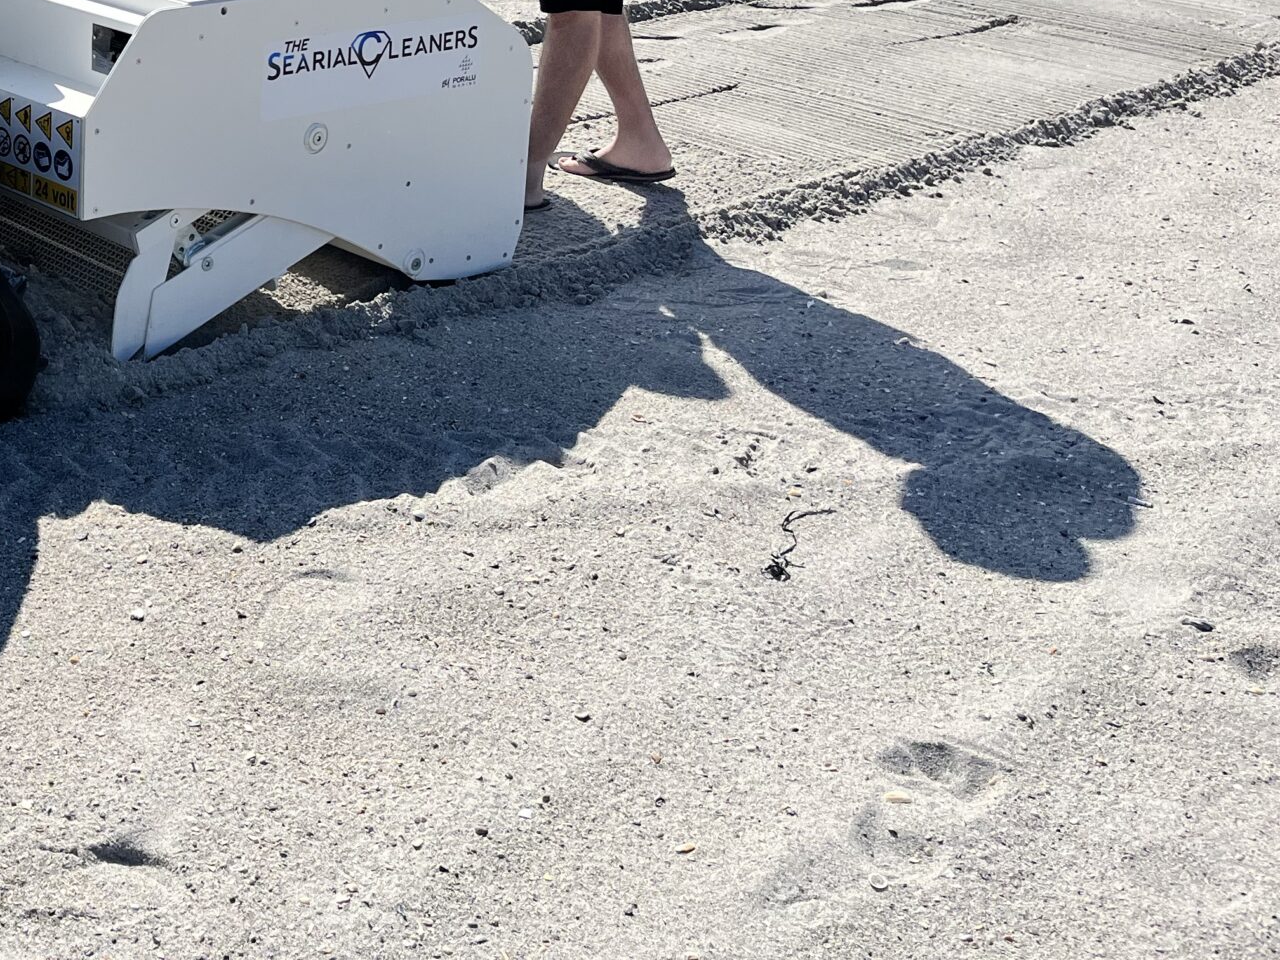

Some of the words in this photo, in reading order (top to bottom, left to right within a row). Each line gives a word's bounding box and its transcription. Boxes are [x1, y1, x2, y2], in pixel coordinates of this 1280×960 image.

[267, 46, 358, 81] SEARIAL
[357, 25, 478, 66] CLEANERS
[284, 38, 310, 54] THE
[452, 74, 477, 84] PORALU
[34, 178, 49, 200] 24
[52, 187, 76, 212] volt
